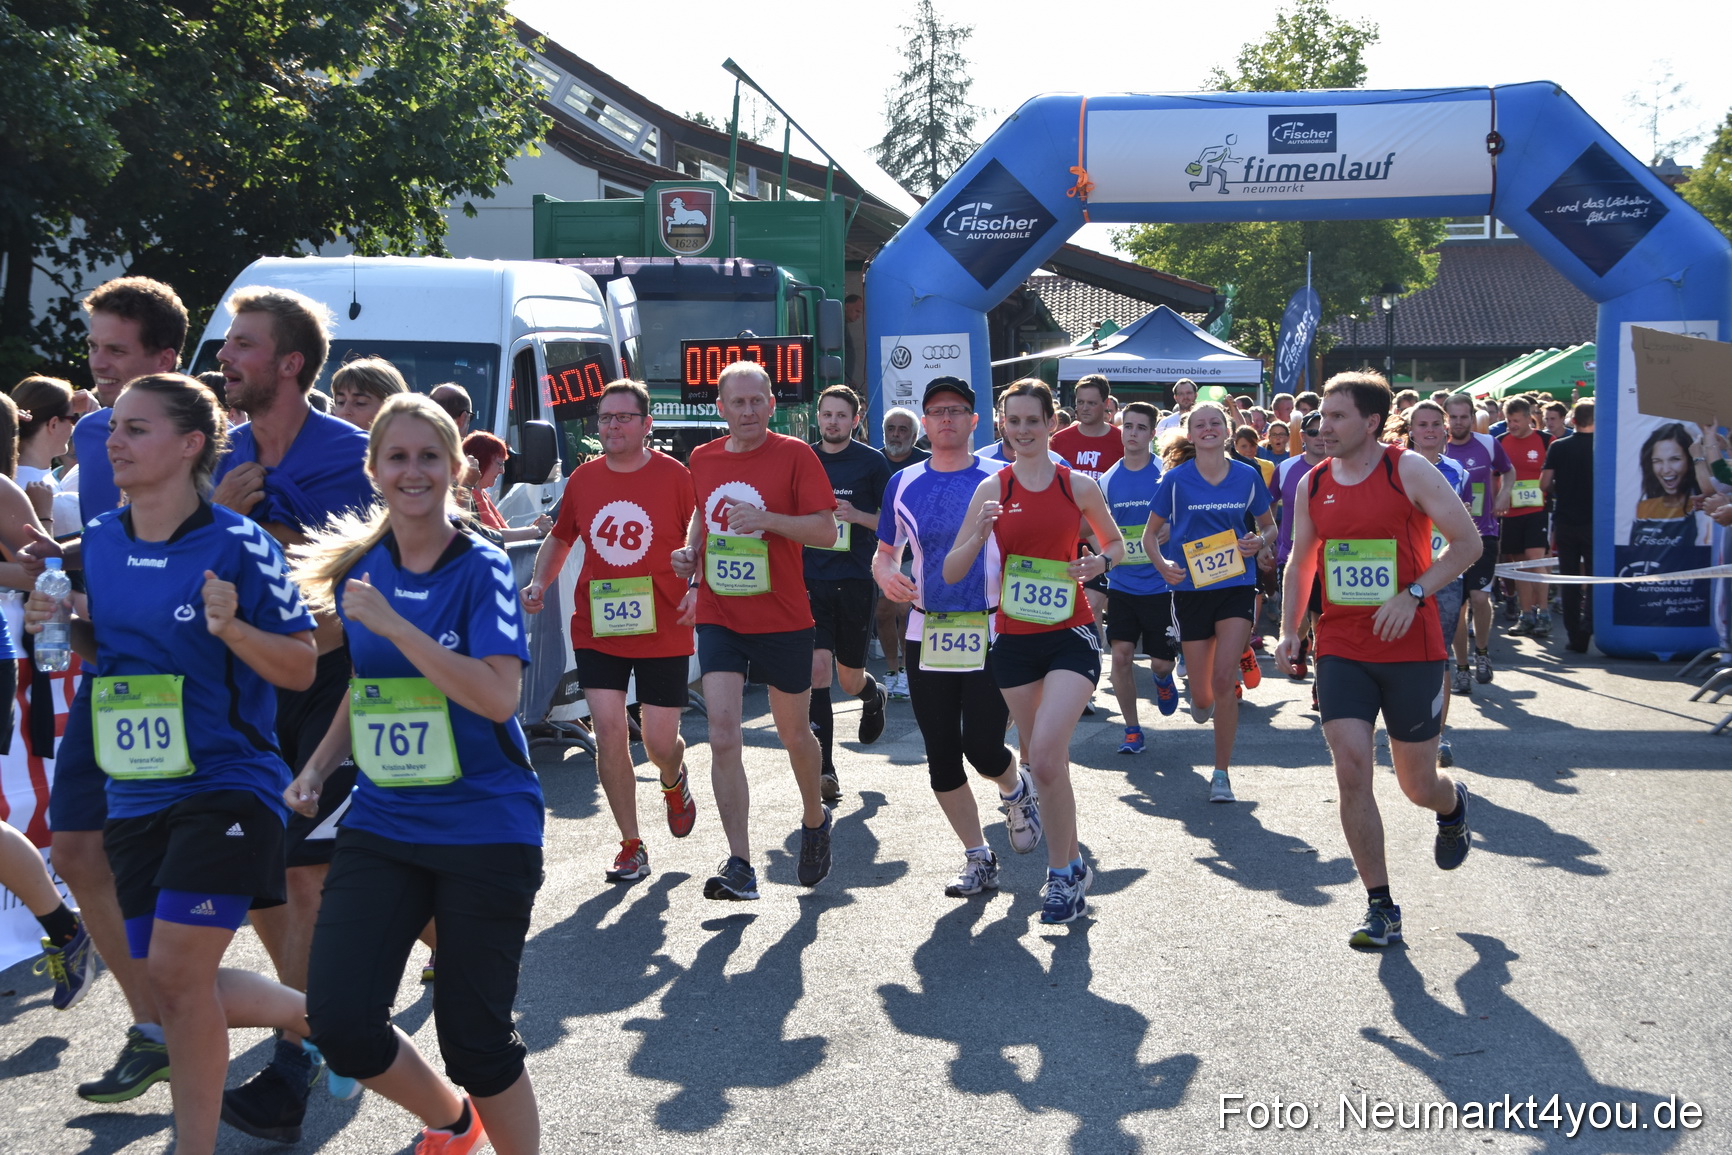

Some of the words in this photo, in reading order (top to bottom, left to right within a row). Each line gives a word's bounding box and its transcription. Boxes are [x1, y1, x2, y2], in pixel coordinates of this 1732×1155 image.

[1283, 129, 1333, 140] Fischer
[1243, 152, 1396, 183] firmenlauf
[1242, 183, 1305, 194] neumarkt
[1581, 197, 1605, 209] das
[959, 215, 1039, 231] Fischer
[675, 239, 699, 248] 1628
[966, 231, 1031, 240] AUTOMOBILE
[1097, 365, 1222, 376] www.fischer-automobile.de
[1076, 450, 1102, 469] MRT
[1517, 490, 1537, 500] 194
[1187, 502, 1247, 511] energiegeladen
[596, 515, 645, 551] 48
[127, 554, 169, 568] hummel
[1194, 548, 1236, 574] 1327
[716, 559, 756, 580] 552
[1332, 565, 1390, 588] 1386
[394, 586, 430, 600] hummel
[1010, 581, 1069, 609] 1385
[603, 600, 642, 621] 543
[929, 632, 981, 652] 1543
[116, 716, 171, 750] 819
[368, 721, 430, 757] 767
[405, 763, 427, 771] Meyer
